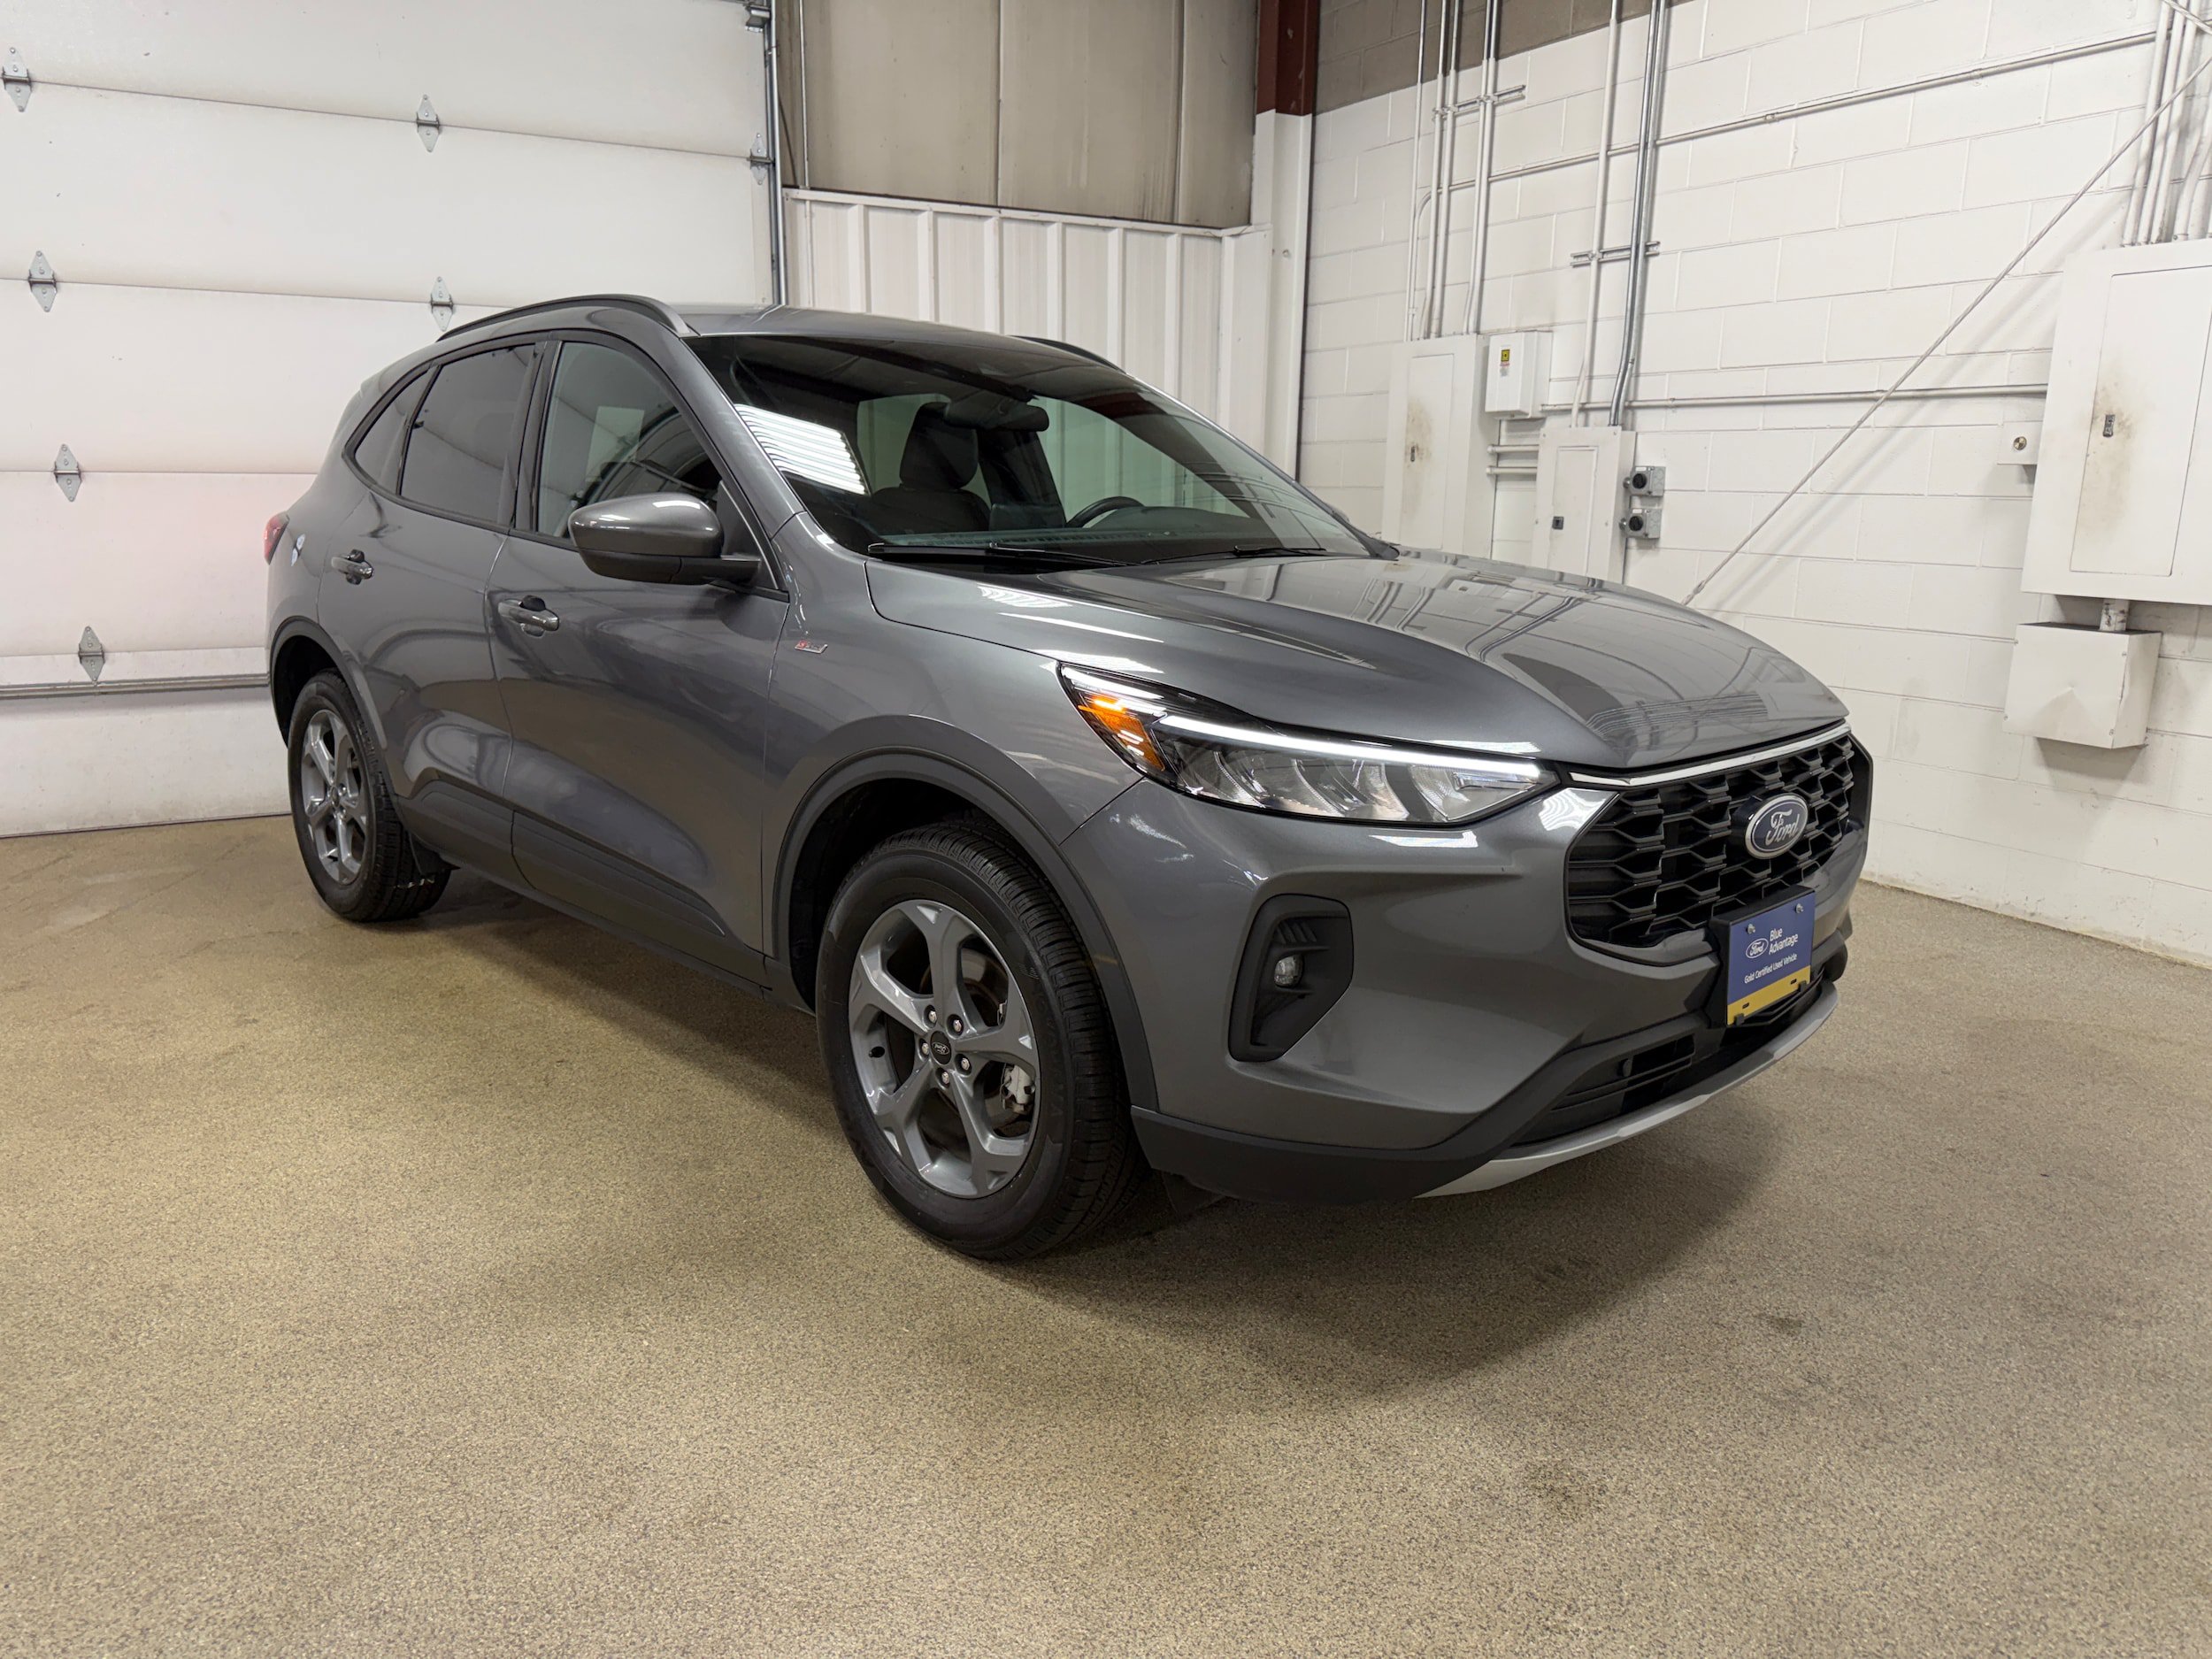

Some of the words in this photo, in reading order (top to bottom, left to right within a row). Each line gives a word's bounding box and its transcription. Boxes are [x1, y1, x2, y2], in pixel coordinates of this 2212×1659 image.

[1765, 809, 1800, 846] Ford
[1769, 933, 1798, 955] Advantage
[1770, 928, 1783, 941] Blue
[1744, 972, 1755, 984] Gold
[1755, 964, 1773, 979] Certified
[1772, 960, 1783, 971] Used
[1783, 953, 1798, 965] Vehicle
